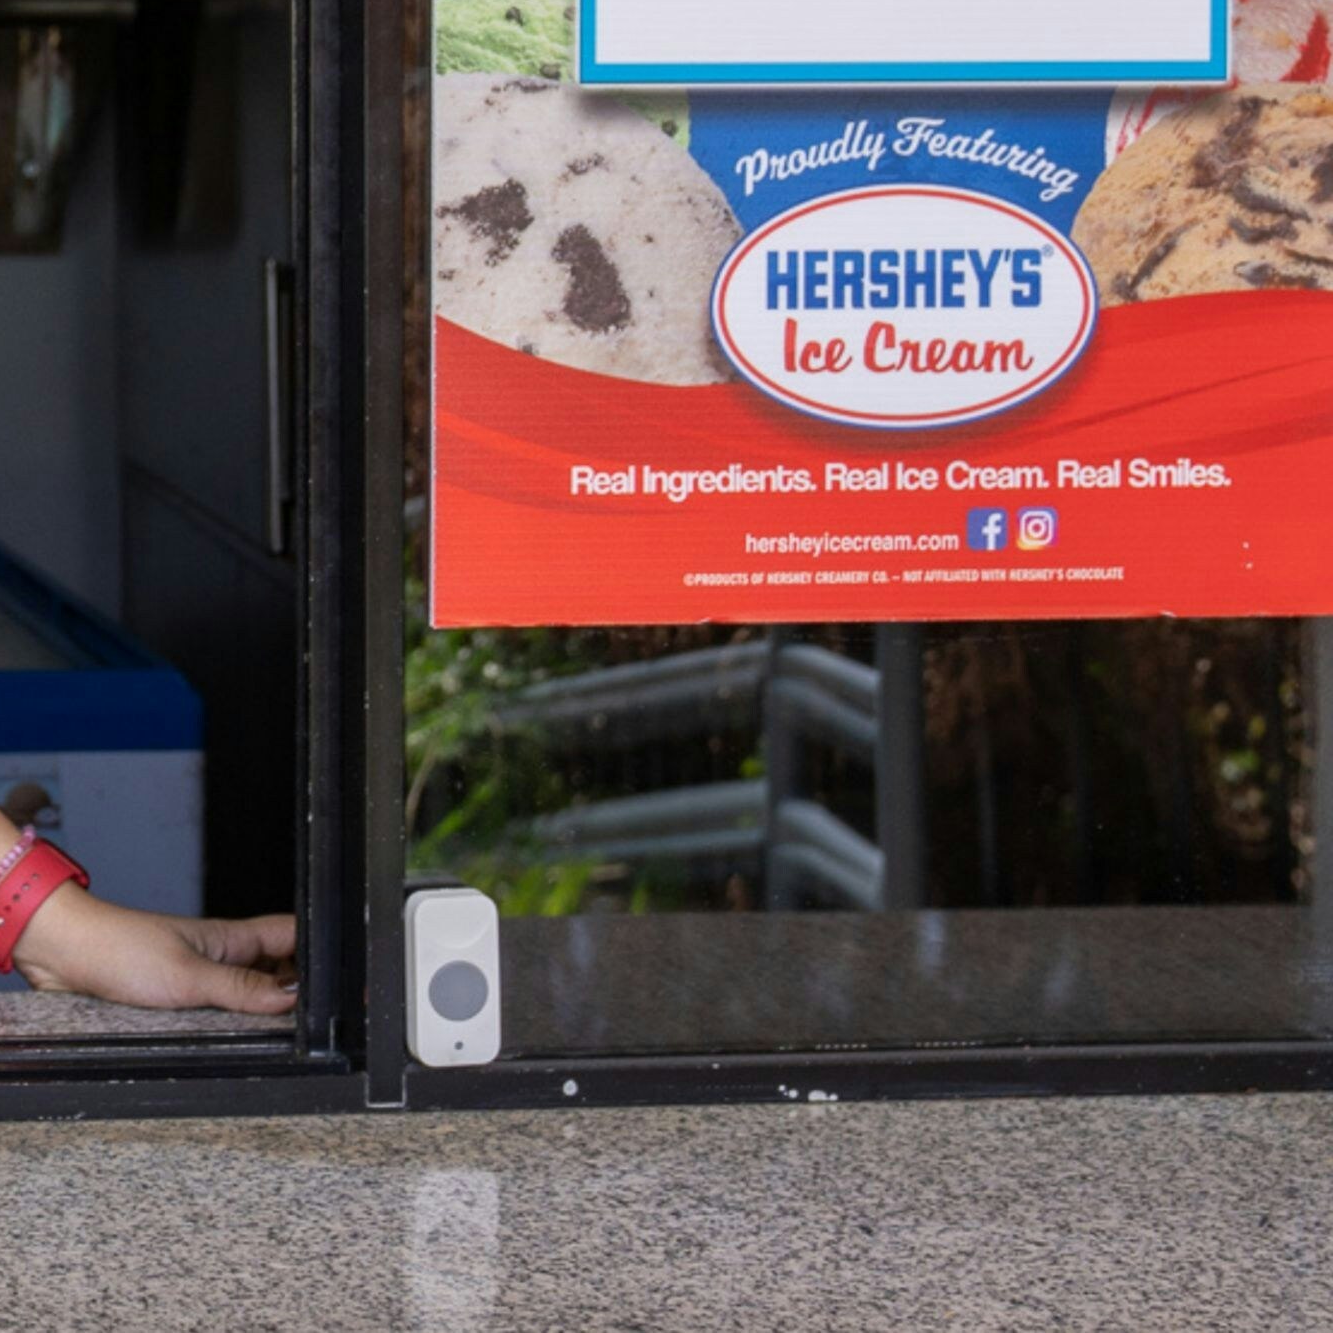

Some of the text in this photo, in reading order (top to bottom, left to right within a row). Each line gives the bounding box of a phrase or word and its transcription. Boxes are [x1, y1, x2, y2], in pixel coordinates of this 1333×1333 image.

[736, 117, 1079, 201] Proudly Featuring
[784, 318, 1033, 375] Ice Cream
[571, 458, 1229, 502] Real Ingredients. Real Ice Cream. Real Smiles.
[745, 530, 960, 557] hersheyicecream.com
[751, 572, 764, 585] OF
[767, 572, 812, 584] HERSHEY
[815, 571, 871, 584] CREAMERY
[871, 571, 889, 584] CO.
[902, 570, 923, 583] NOT
[923, 569, 980, 582] AFFILIATED
[980, 569, 1007, 581] WITH
[1007, 568, 1064, 582] HERSHEY'S
[1065, 567, 1124, 580] CHOCOLATE
